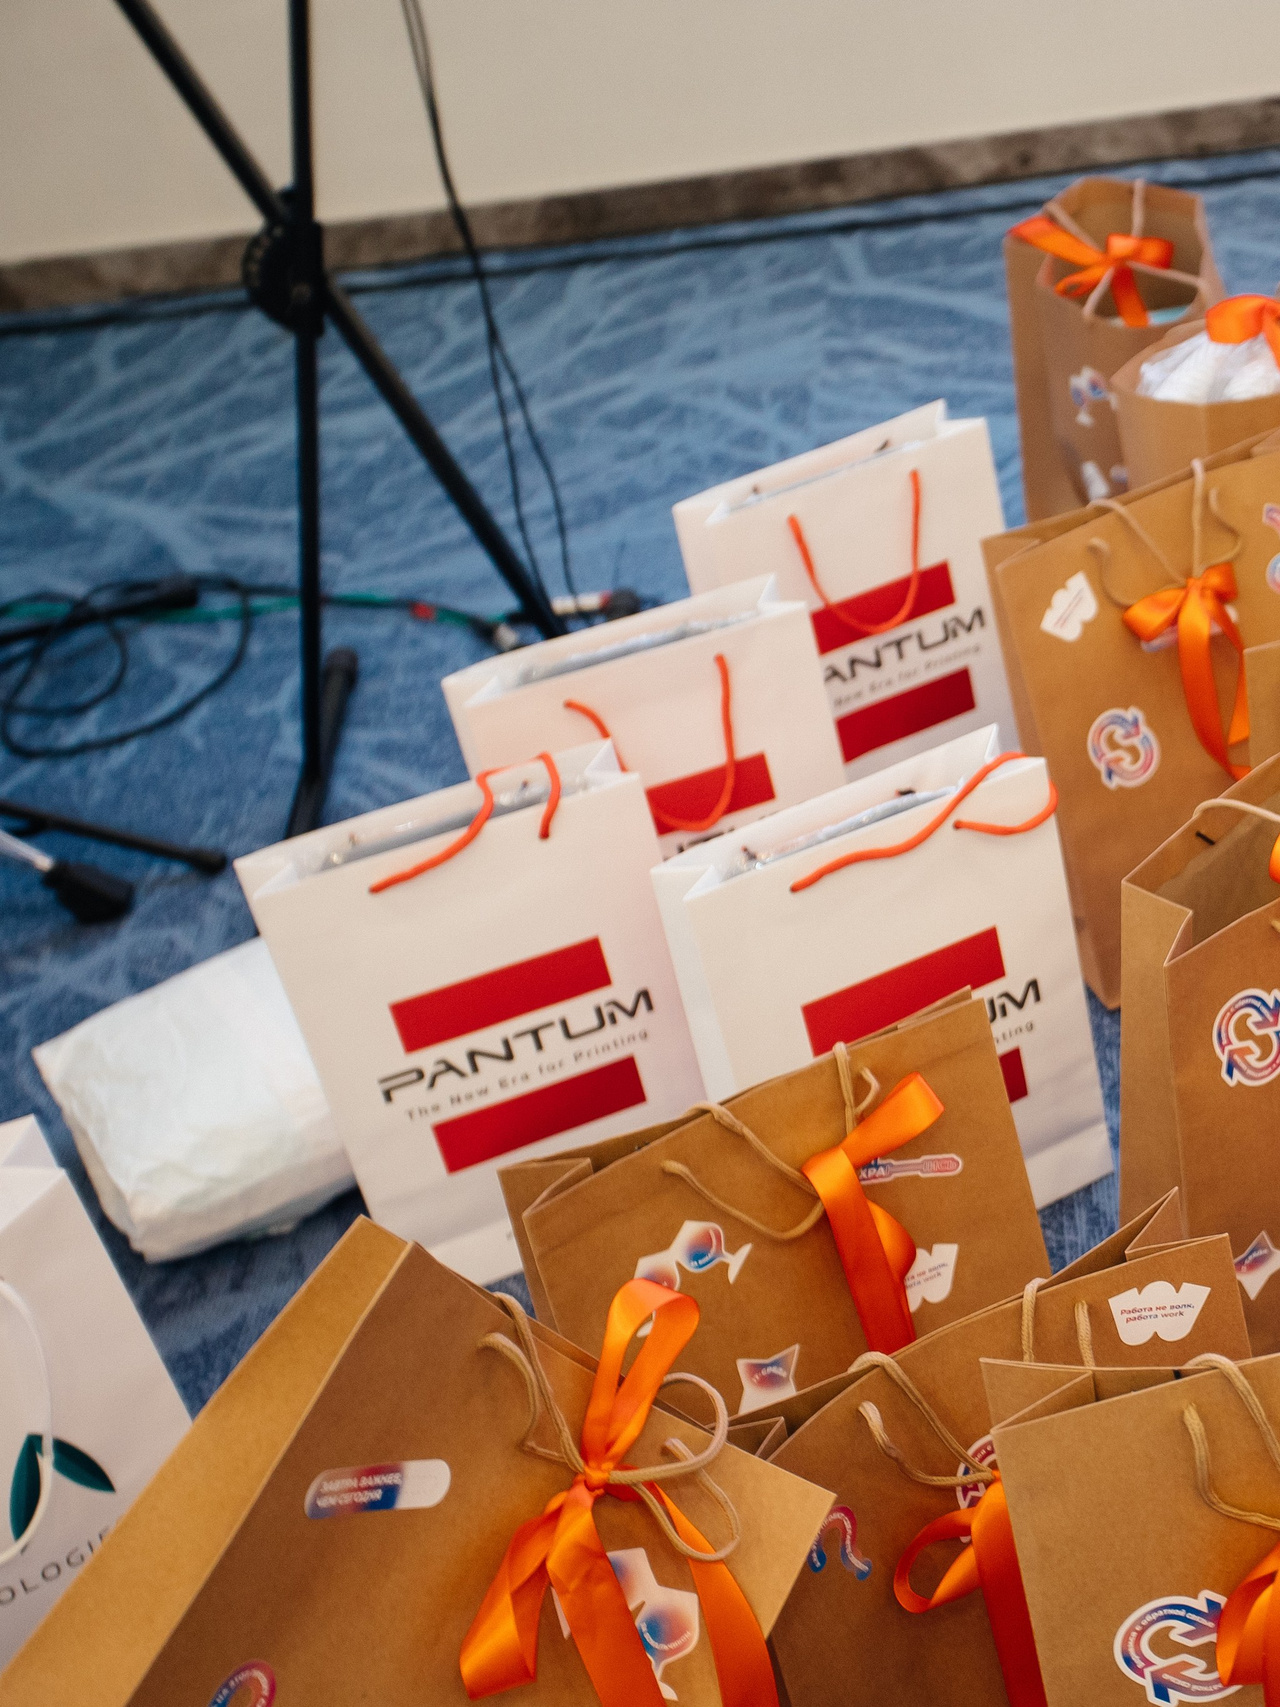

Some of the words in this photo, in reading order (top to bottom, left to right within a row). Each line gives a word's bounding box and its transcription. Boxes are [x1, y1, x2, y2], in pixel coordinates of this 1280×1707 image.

[824, 606, 985, 682] ANTUM
[377, 987, 654, 1104] PANTUM
[1120, 1304, 1153, 1316] Работа
[1125, 1313, 1158, 1324] работа
[1161, 1310, 1184, 1318] work
